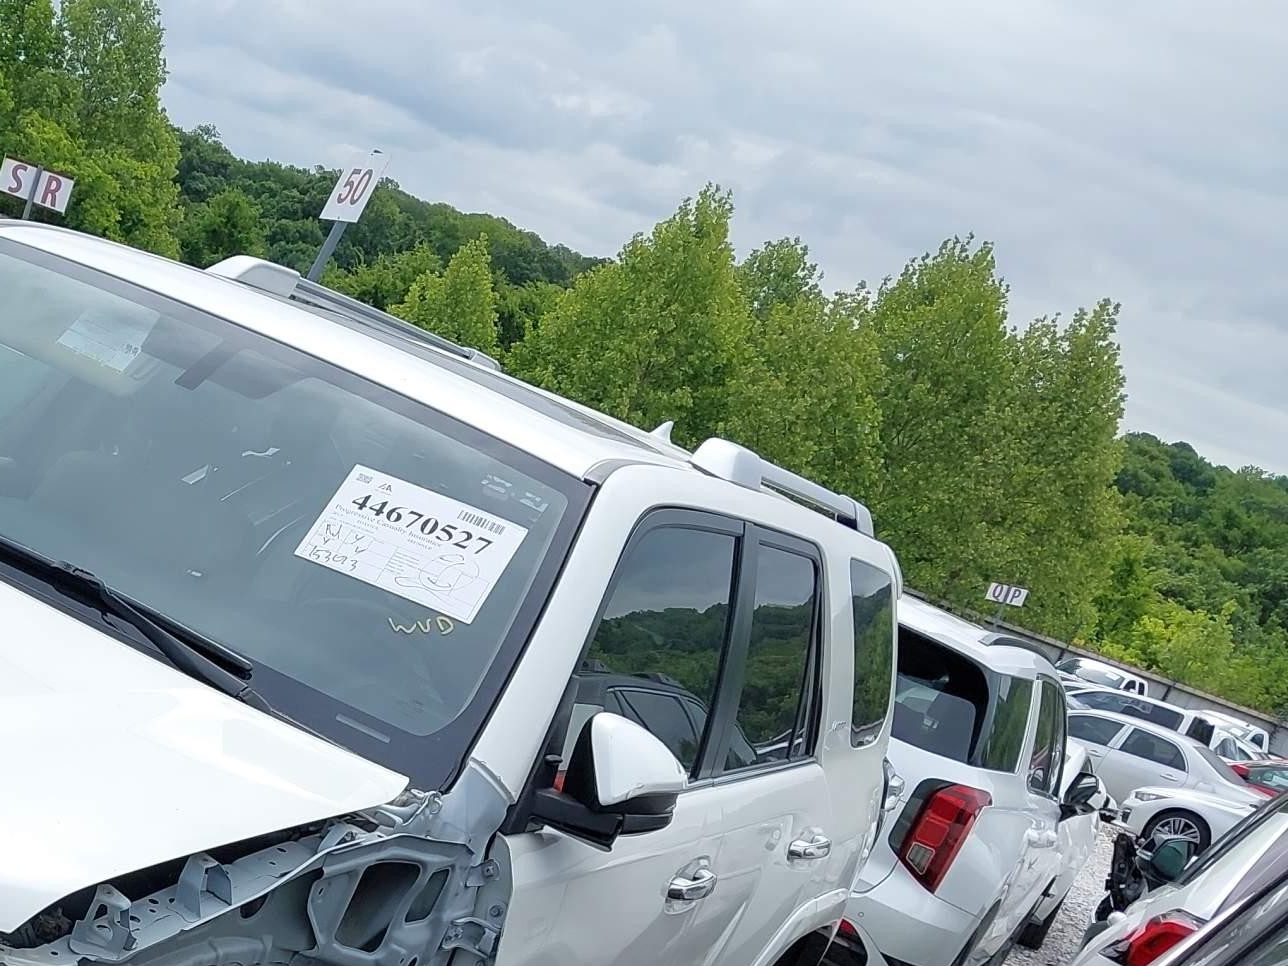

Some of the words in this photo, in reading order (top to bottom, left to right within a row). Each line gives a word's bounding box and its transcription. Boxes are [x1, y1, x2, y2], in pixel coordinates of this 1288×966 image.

[8, 164, 28, 193] S
[40, 175, 62, 208] R
[337, 168, 373, 206] 50
[335, 503, 376, 523] Progressive
[376, 518, 407, 535] Casualty
[408, 530, 442, 548] Insurance
[352, 494, 494, 555] 44670527
[1009, 588, 1022, 604] P
